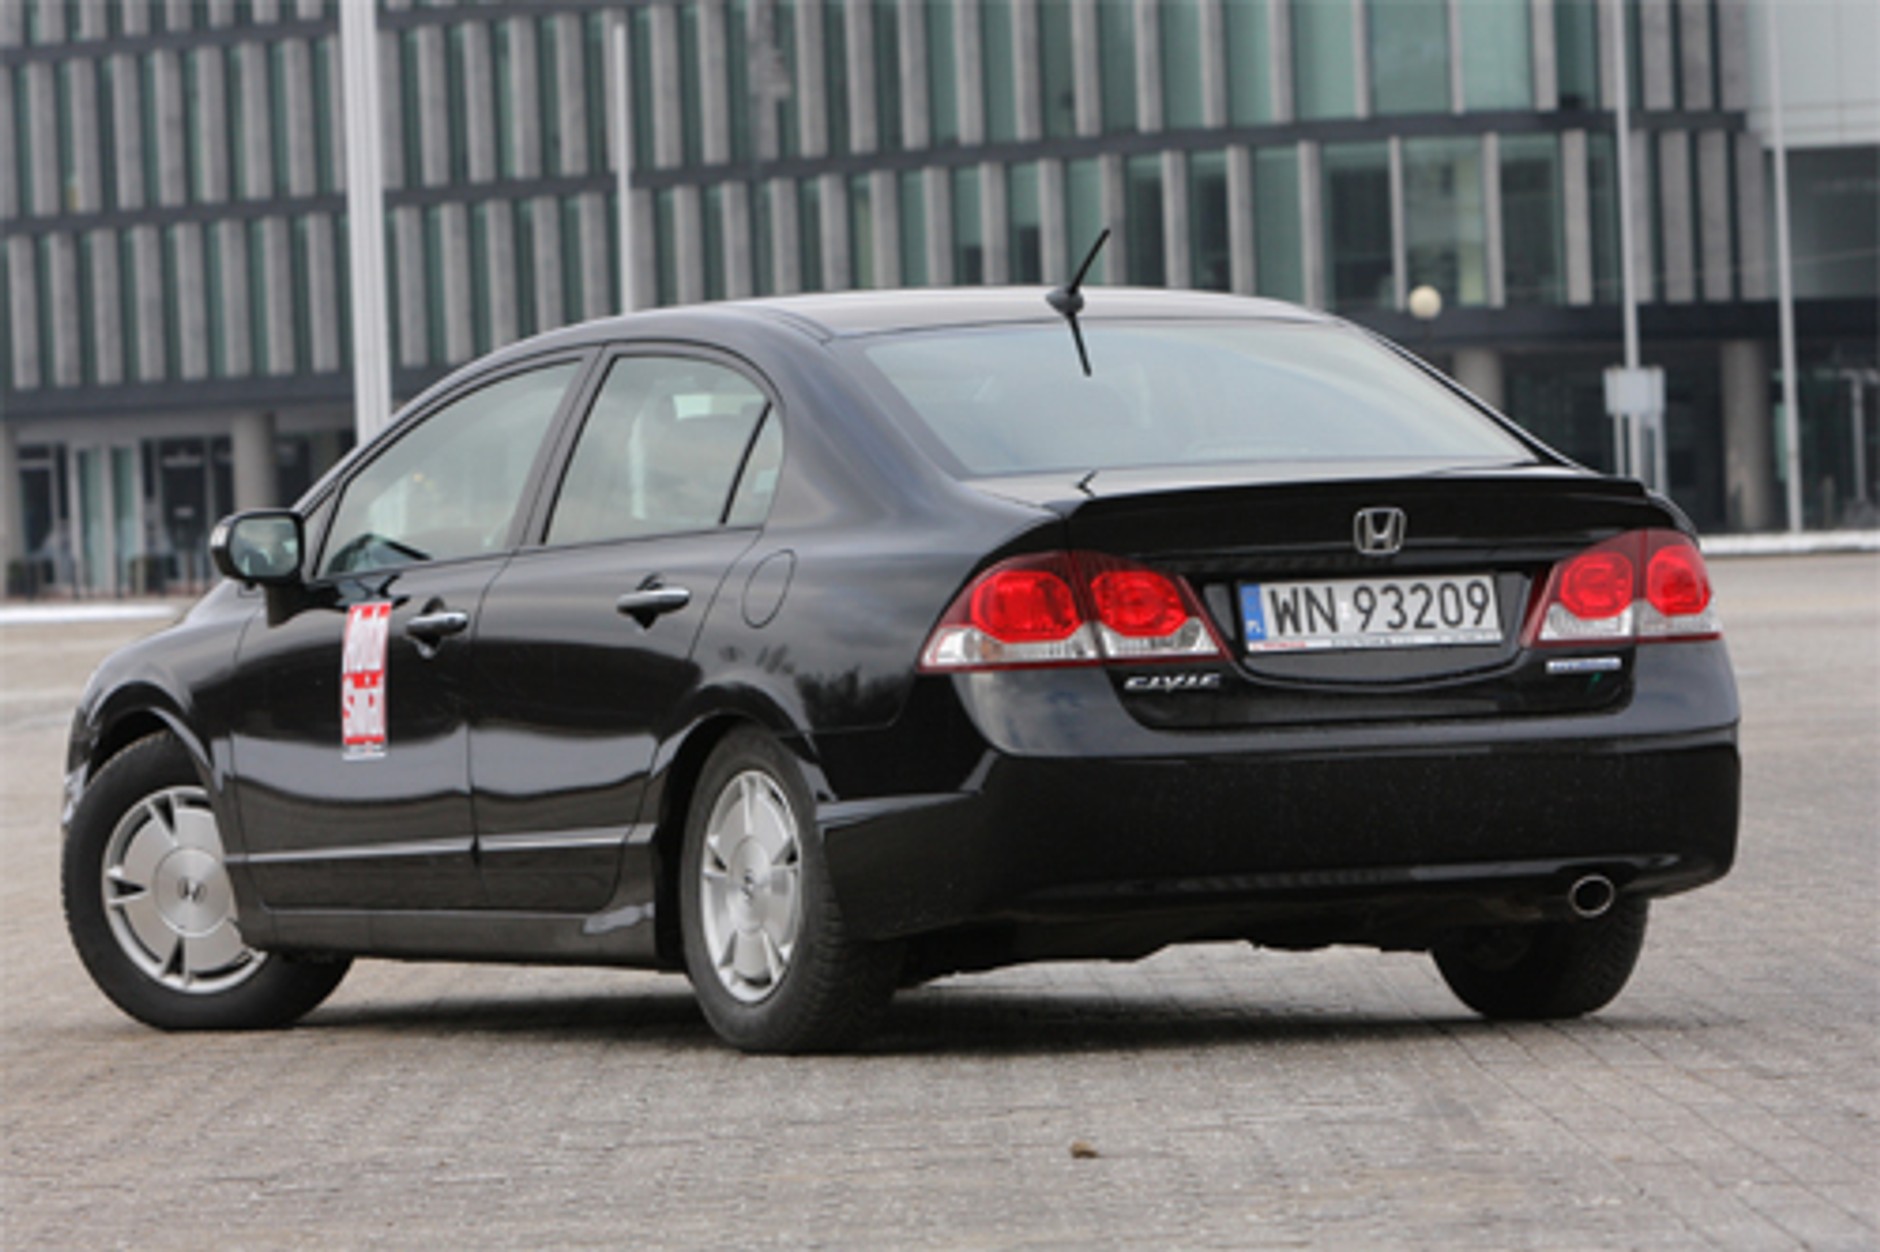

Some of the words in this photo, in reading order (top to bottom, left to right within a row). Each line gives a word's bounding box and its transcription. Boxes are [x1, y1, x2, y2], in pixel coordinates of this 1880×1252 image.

[1268, 586, 1338, 635] WN
[1353, 579, 1490, 632] 93209
[1124, 673, 1221, 693] CIVIC
